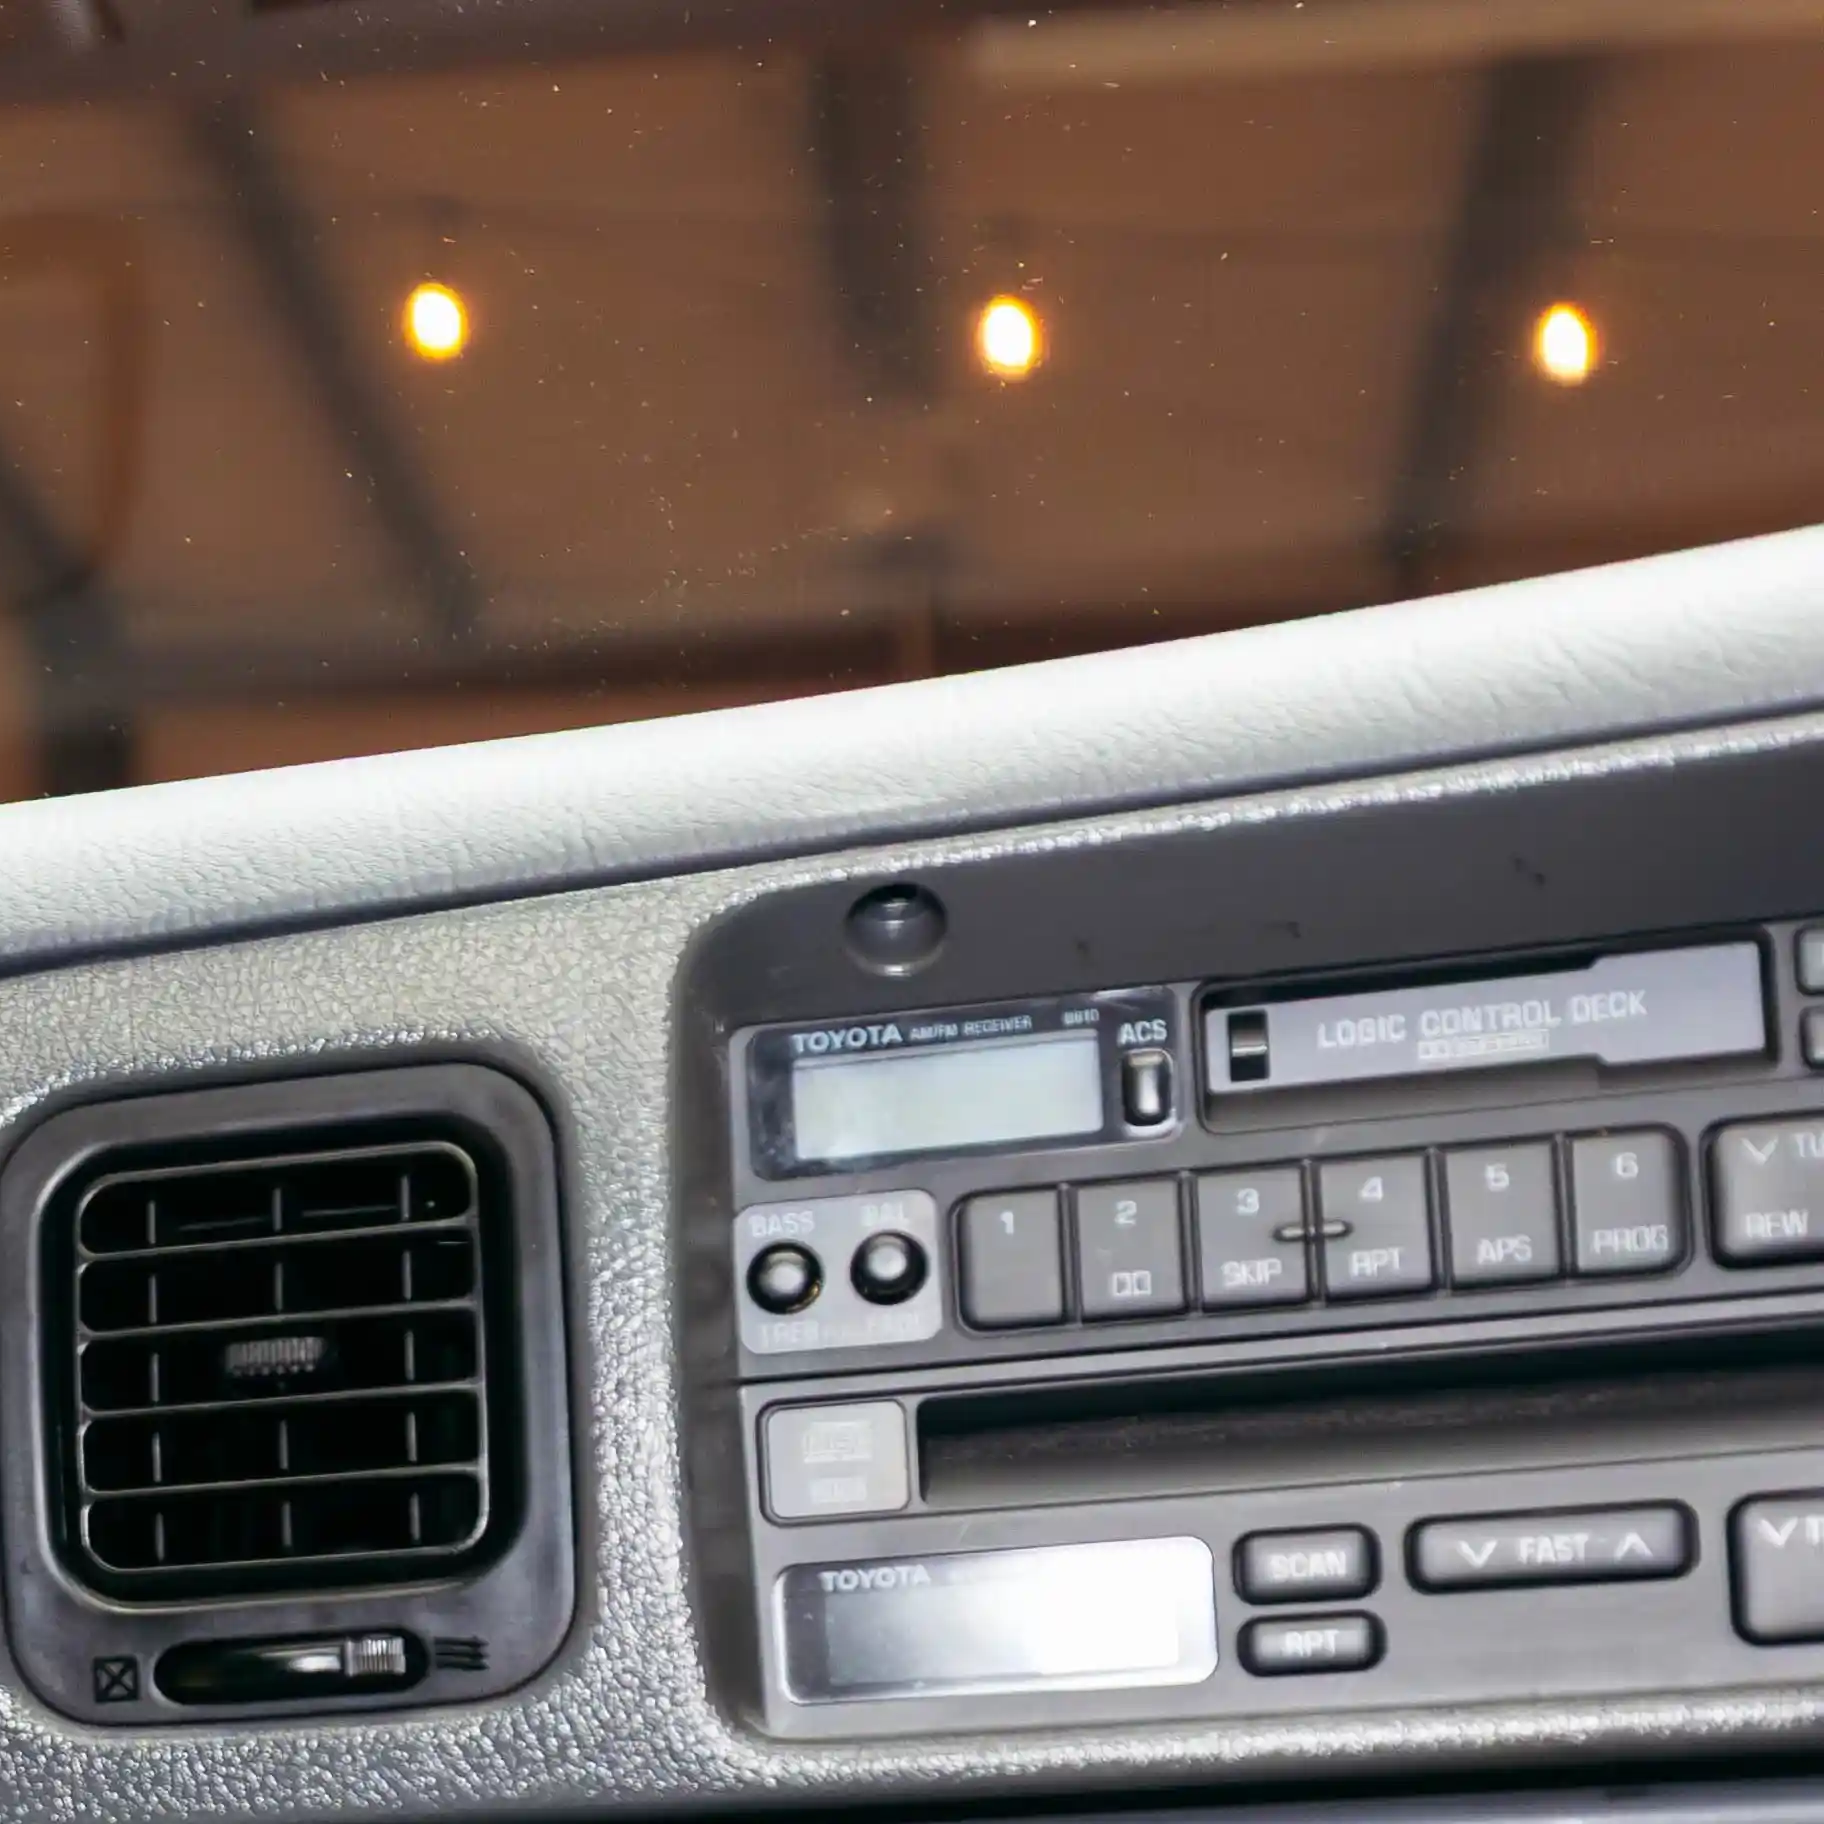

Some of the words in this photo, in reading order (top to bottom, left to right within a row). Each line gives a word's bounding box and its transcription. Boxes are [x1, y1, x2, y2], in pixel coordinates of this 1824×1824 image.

[1118, 1019, 1168, 1045] ACS
[1317, 1014, 1406, 1049] LOGIC
[1421, 1000, 1562, 1038] CONTROL
[1572, 990, 1648, 1024] DECK
[790, 1023, 903, 1053] TOYOTA
[1485, 1163, 1510, 1189] 5
[1614, 1152, 1638, 1179] 6
[1237, 1189, 1260, 1214] 3
[1360, 1177, 1383, 1200] 4
[750, 1210, 815, 1237] BASS
[999, 1212, 1015, 1234] 1
[1115, 1203, 1136, 1225] 2
[1478, 1235, 1533, 1266] APS
[1593, 1224, 1670, 1254] PROG
[1222, 1259, 1282, 1287] SKIP
[1518, 1532, 1589, 1562] FAST
[819, 1564, 931, 1592] TOYOTA
[1270, 1551, 1348, 1580] SCAN
